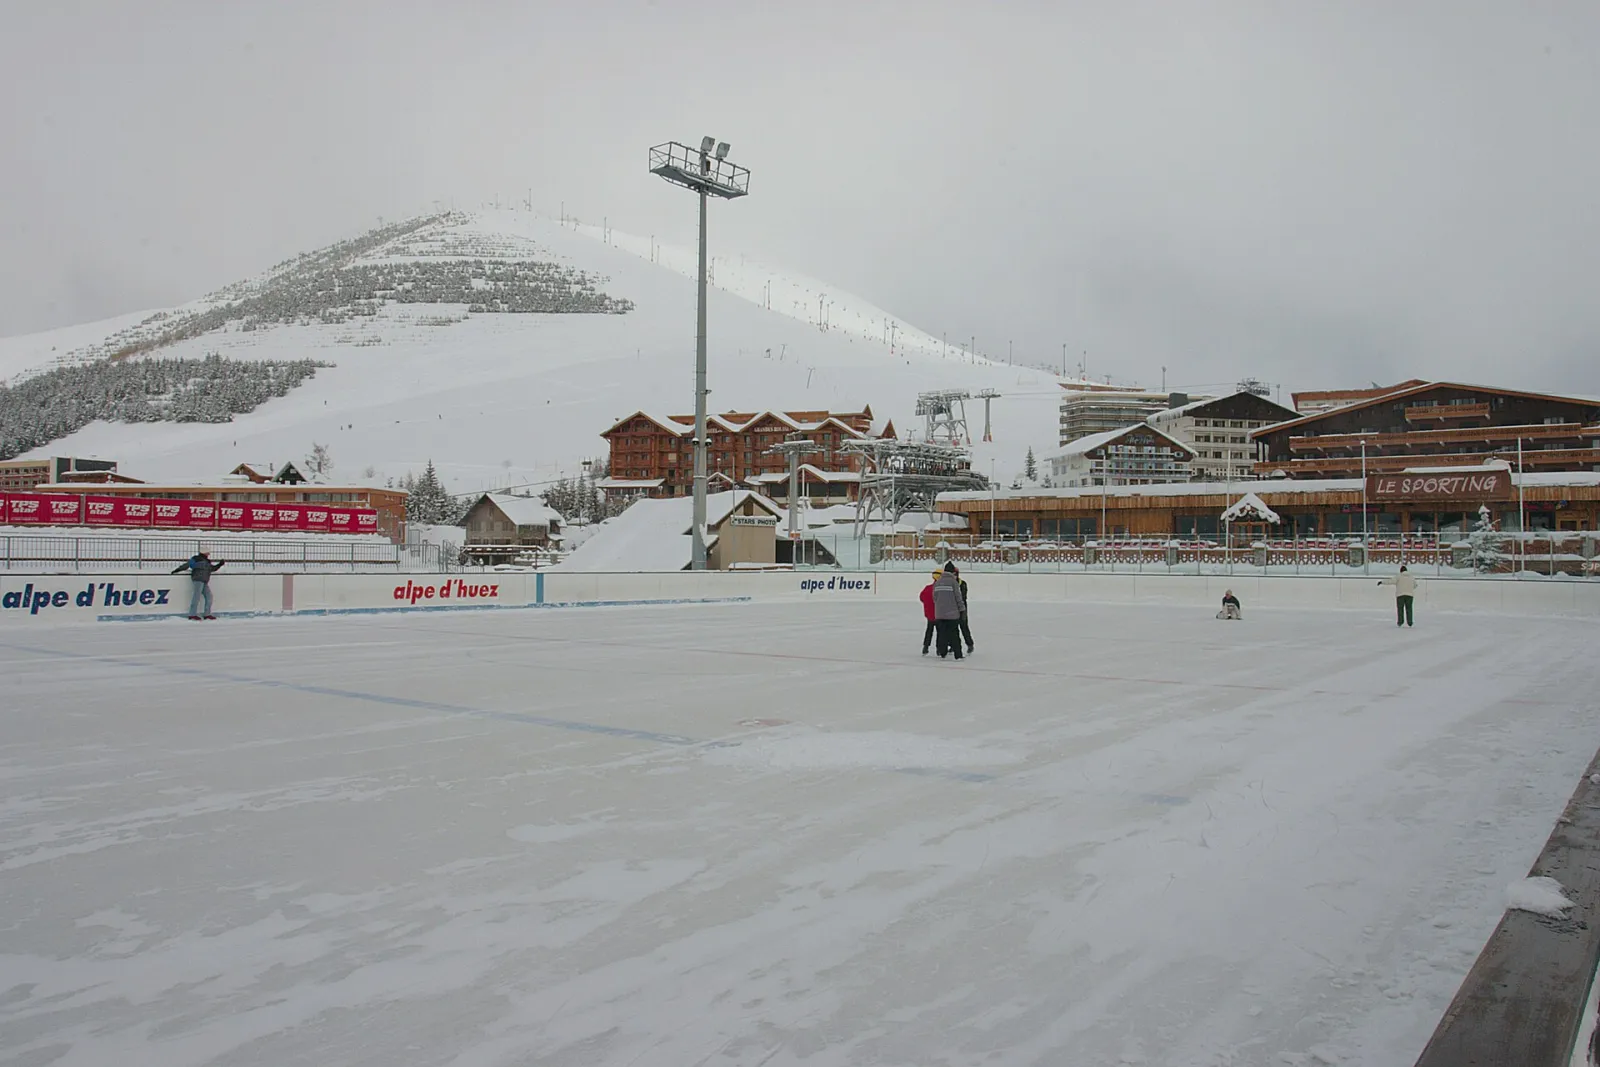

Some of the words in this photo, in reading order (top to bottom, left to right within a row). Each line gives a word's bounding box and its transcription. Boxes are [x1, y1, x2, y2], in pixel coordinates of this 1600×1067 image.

[1376, 479, 1396, 493] LE
[1401, 476, 1497, 494] SPORTING
[10, 500, 39, 508] TPS
[50, 501, 79, 510] TPS
[88, 502, 114, 510] TPS
[124, 504, 150, 512] TPS
[189, 506, 214, 514] TPS
[220, 508, 243, 516] TPS
[252, 508, 274, 516] TPS
[278, 510, 299, 518] TPS
[306, 511, 328, 519] TPS
[331, 513, 350, 521] TPS
[358, 514, 377, 522] TPS
[801, 579, 825, 594] alpe
[393, 580, 435, 605] alpe
[2, 583, 69, 615] alpe
